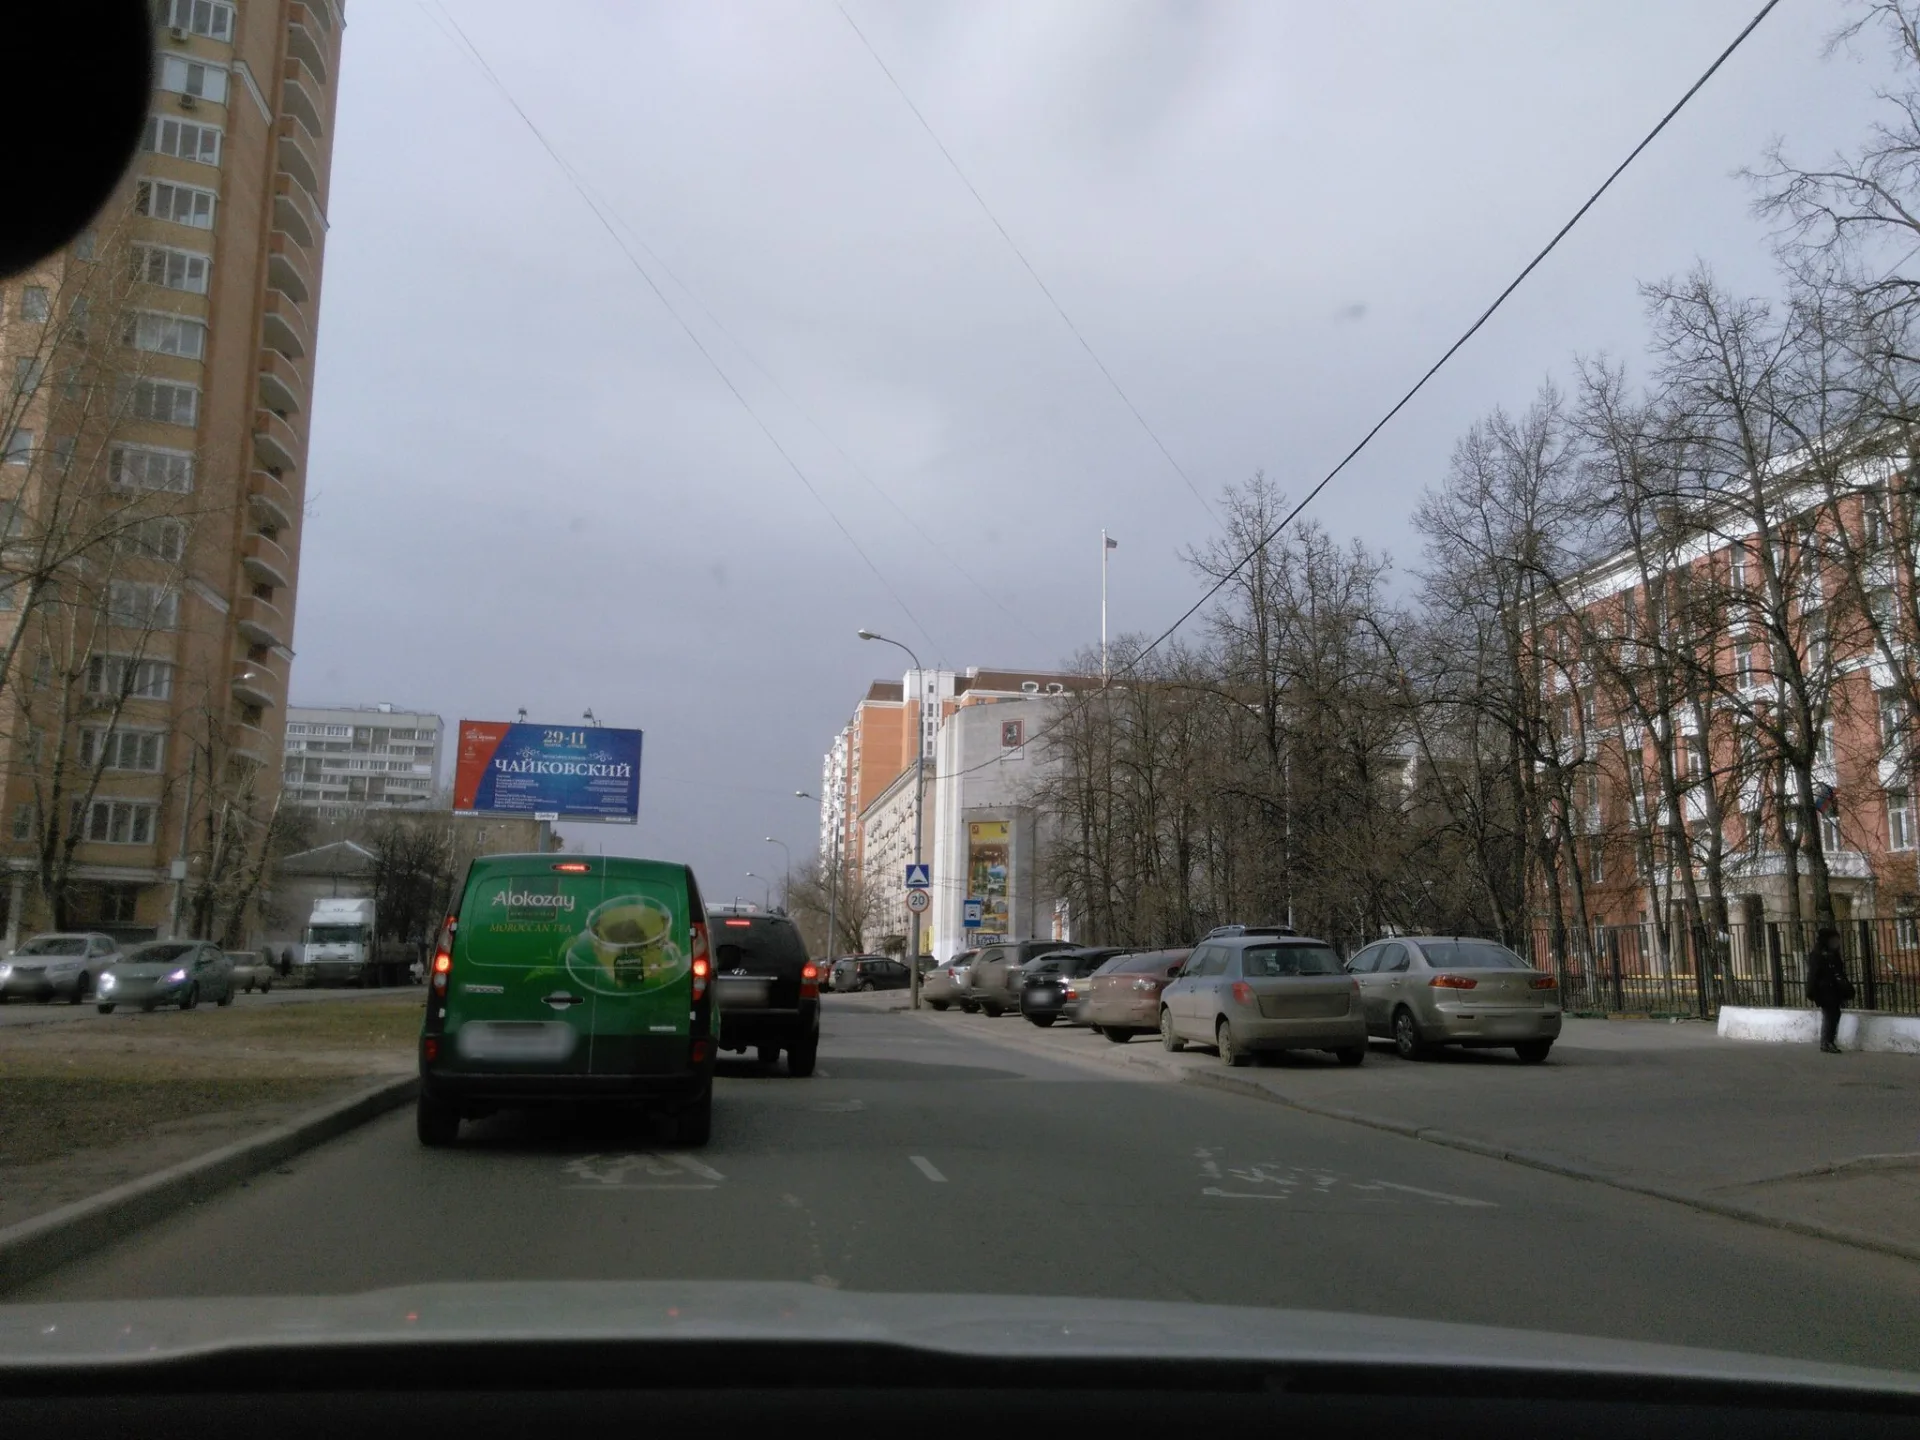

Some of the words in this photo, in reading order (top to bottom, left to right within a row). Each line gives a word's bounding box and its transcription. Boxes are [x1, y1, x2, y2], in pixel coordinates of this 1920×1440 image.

[495, 759, 630, 777] ЧАЙКОВСКИЙ
[491, 890, 575, 912] Alokozay
[912, 896, 925, 906] 20
